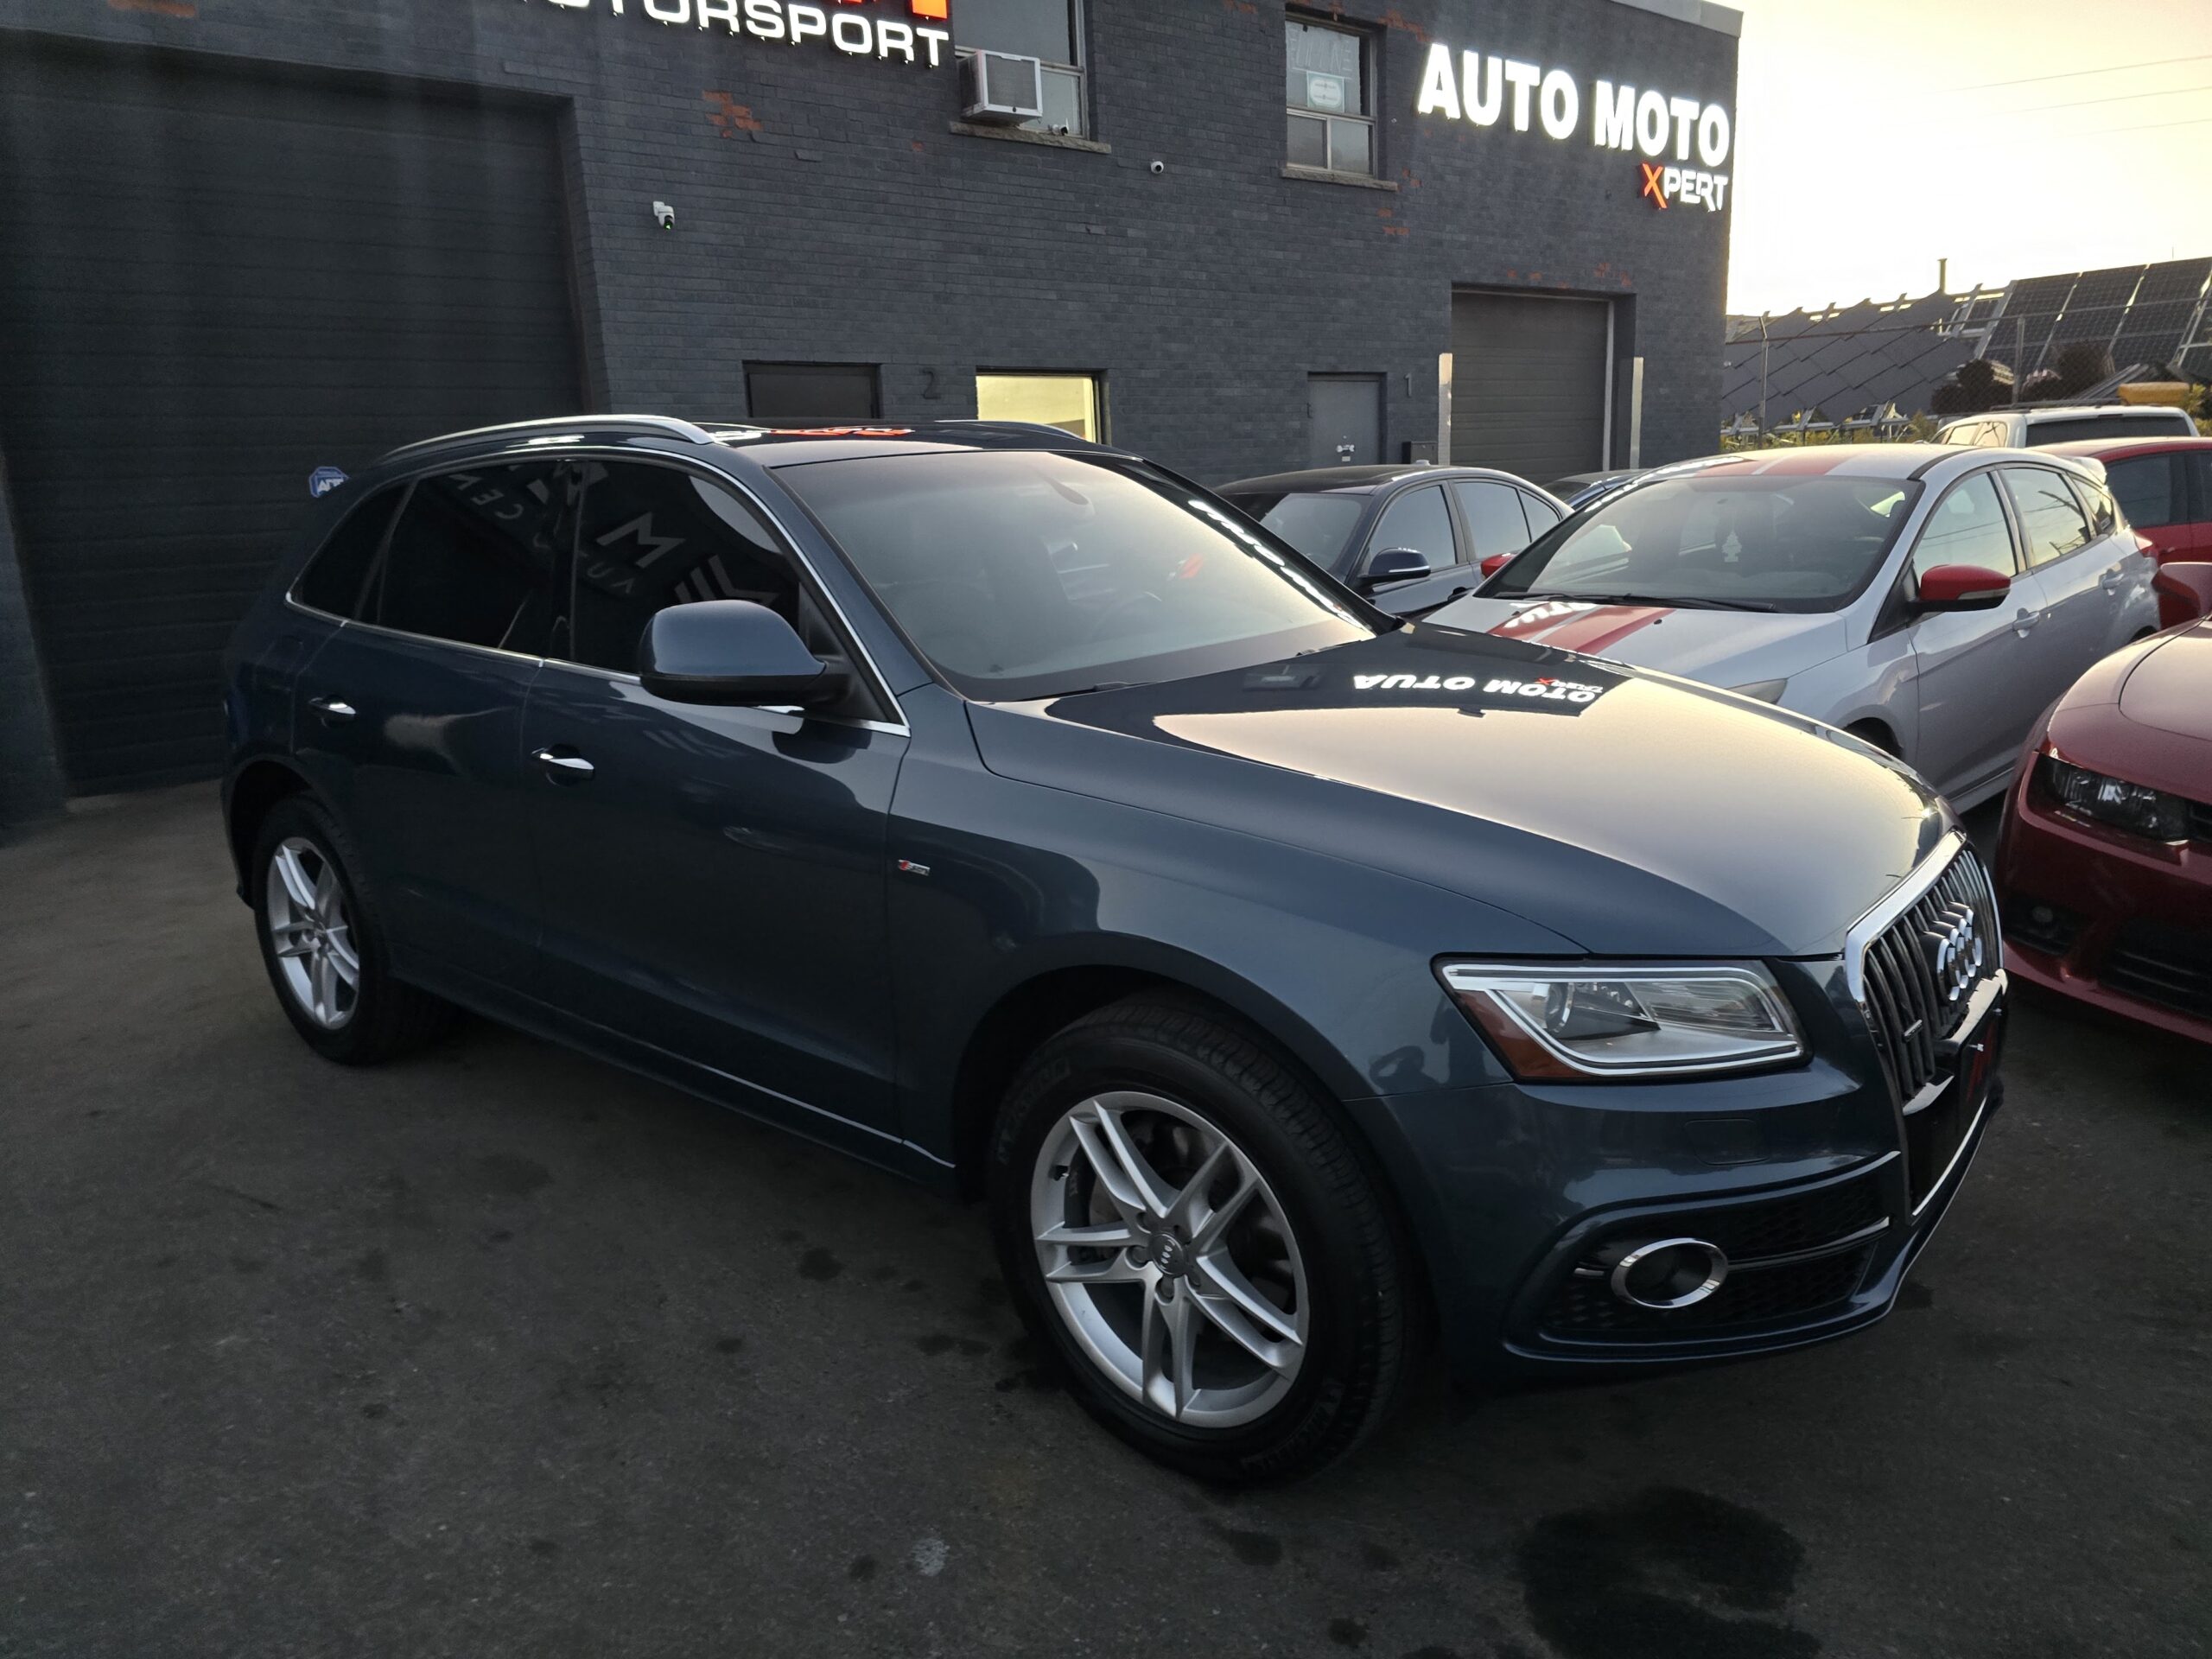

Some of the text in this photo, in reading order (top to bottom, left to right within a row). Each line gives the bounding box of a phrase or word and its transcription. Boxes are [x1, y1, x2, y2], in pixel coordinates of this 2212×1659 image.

[1418, 42, 1729, 166] AUTO MOTO
[1643, 163, 1728, 212] XPERT
[923, 369, 938, 399] 2
